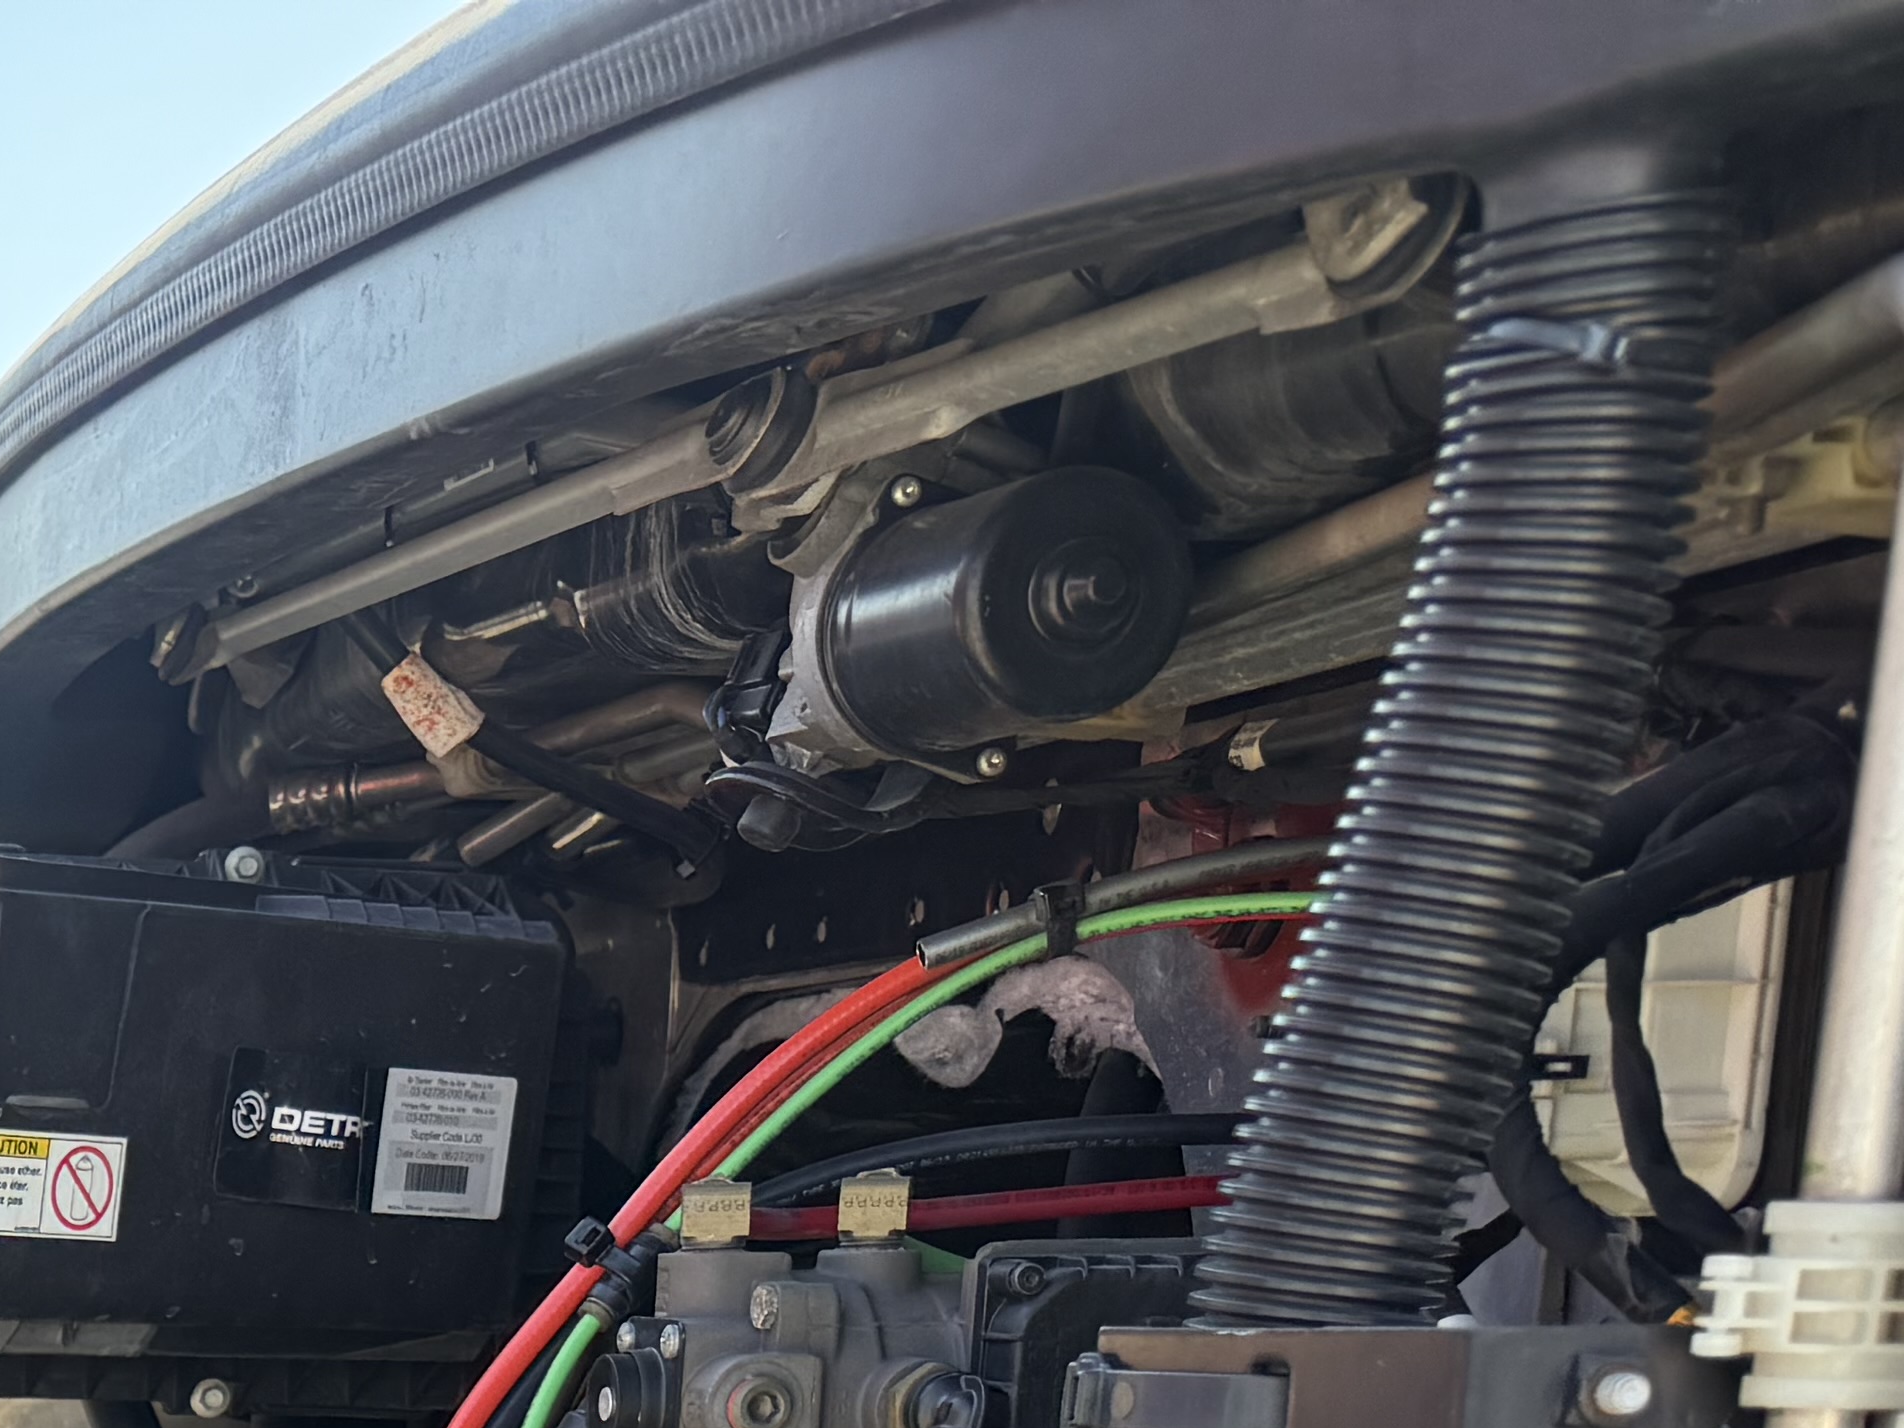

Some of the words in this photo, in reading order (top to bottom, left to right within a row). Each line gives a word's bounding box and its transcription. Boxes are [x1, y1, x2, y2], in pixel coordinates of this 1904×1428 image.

[270, 1133, 314, 1147] GENUINE
[315, 1138, 344, 1150] PARTS
[410, 1129, 441, 1142] Supplier
[443, 1132, 463, 1143] Code
[0, 1166, 15, 1175] use
[7, 1197, 23, 1207] pas
